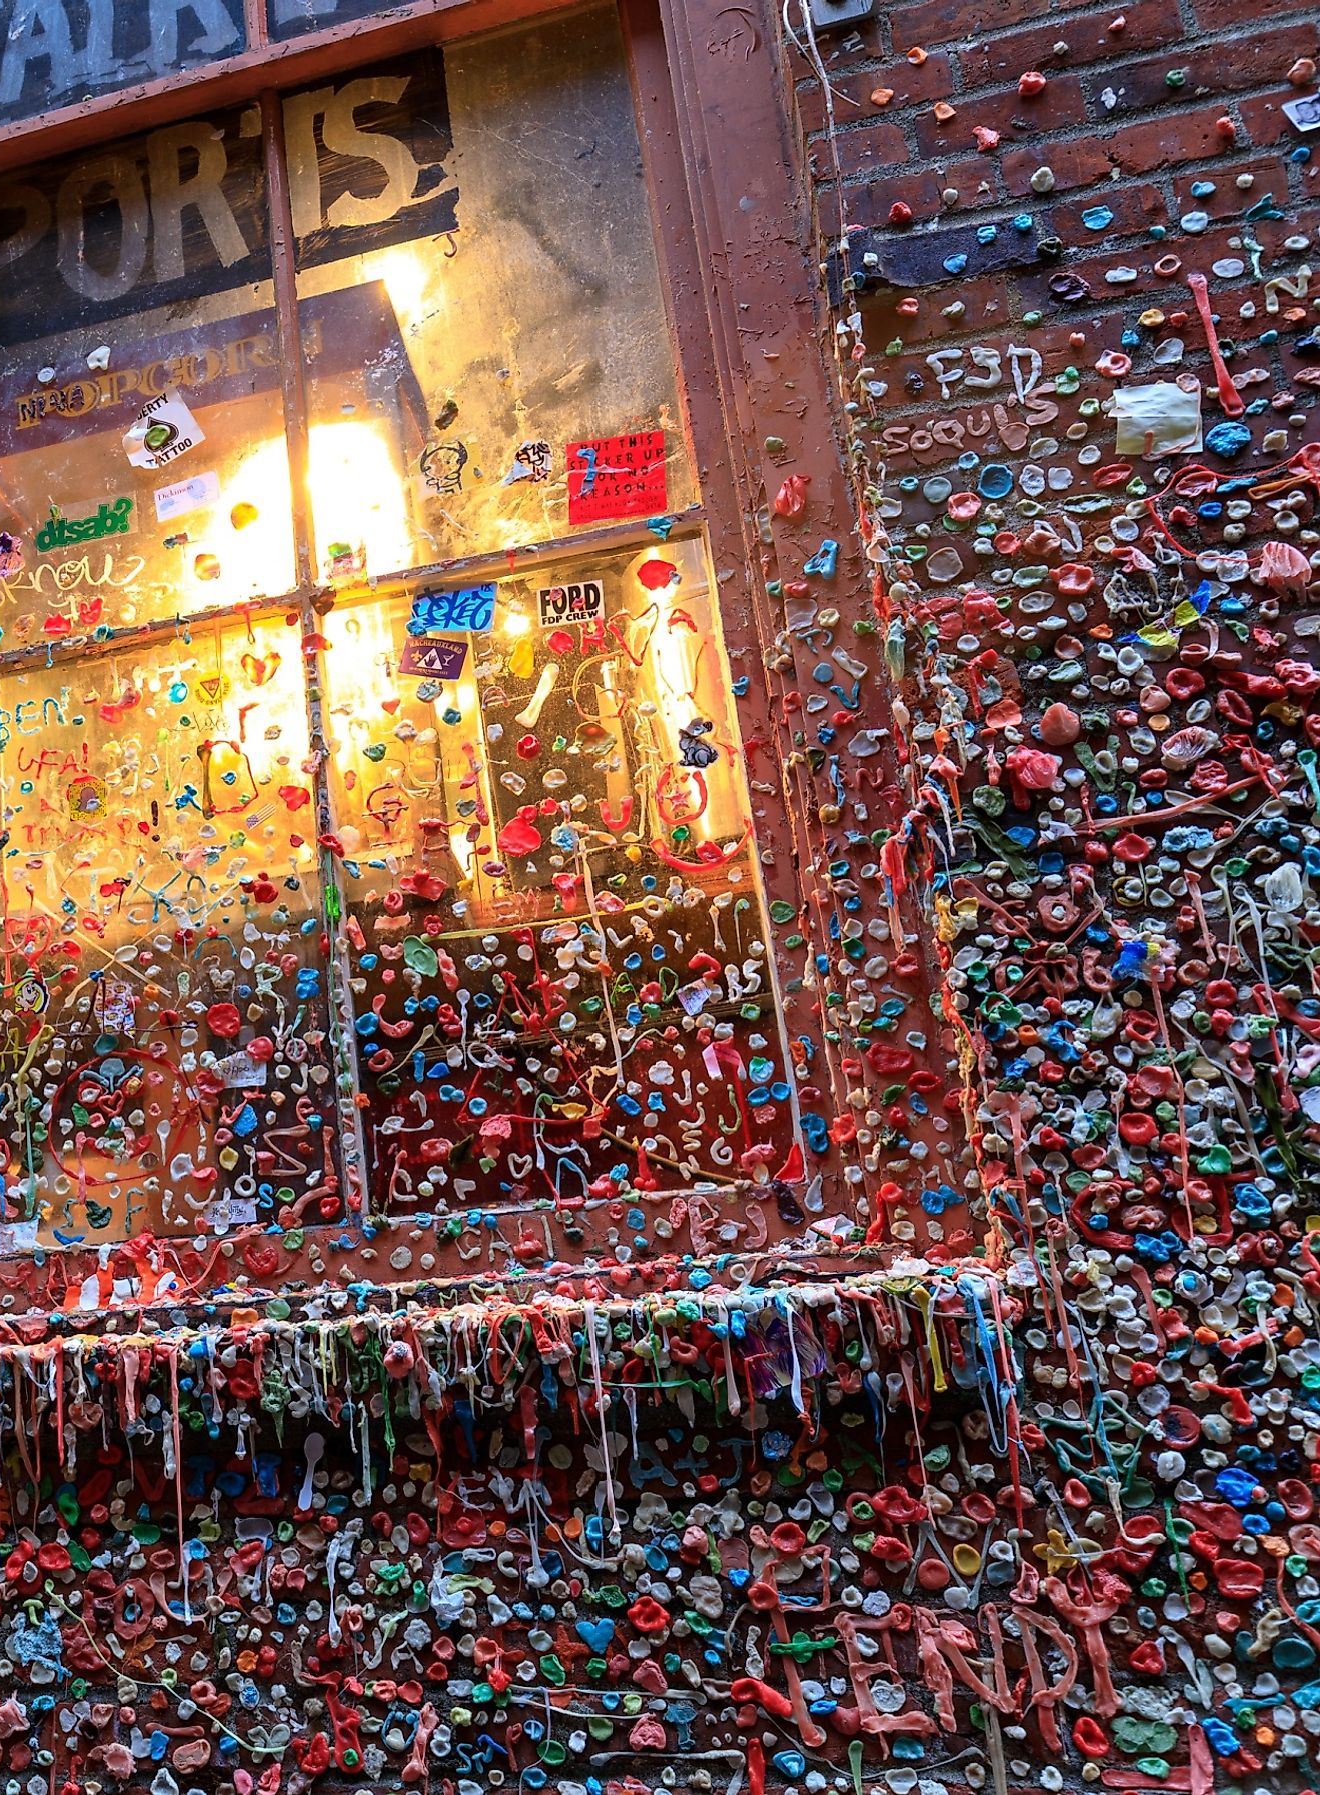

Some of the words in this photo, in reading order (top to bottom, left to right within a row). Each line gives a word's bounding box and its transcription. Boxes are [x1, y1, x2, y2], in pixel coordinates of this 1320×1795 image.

[620, 433, 653, 448] THIS
[146, 438, 193, 467] TATTOO
[570, 453, 634, 470] STCKER
[644, 448, 664, 460] UP
[628, 465, 649, 477] NO
[540, 583, 600, 616] FORD
[542, 616, 561, 625] FDP
[566, 610, 599, 621] CREW
